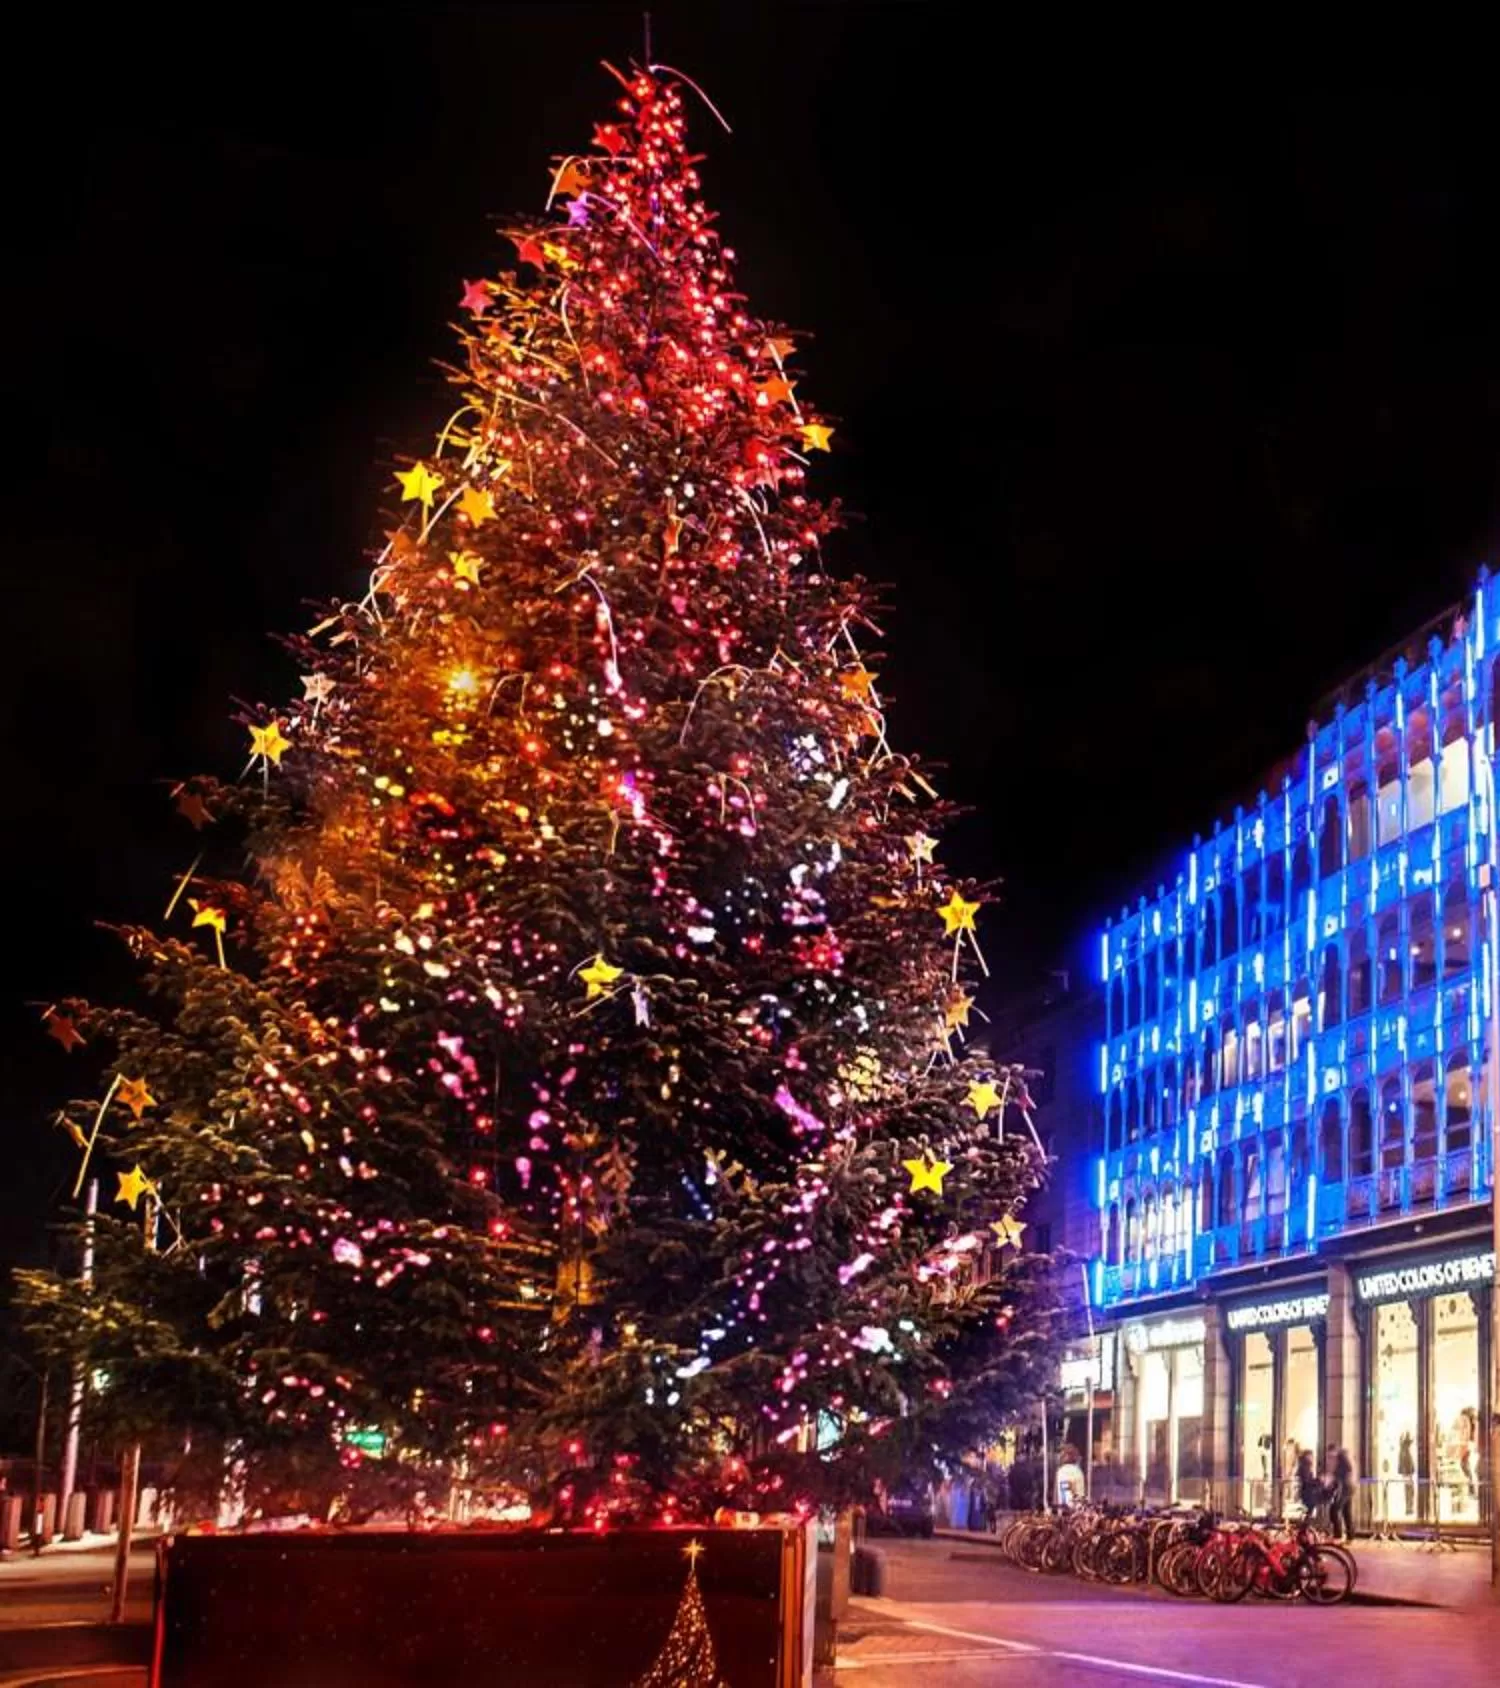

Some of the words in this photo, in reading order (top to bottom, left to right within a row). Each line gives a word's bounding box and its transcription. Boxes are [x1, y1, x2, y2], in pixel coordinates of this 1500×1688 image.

[1358, 1271, 1399, 1299] UNITED
[1399, 1263, 1445, 1293] COLORS
[1444, 1258, 1462, 1285] OF
